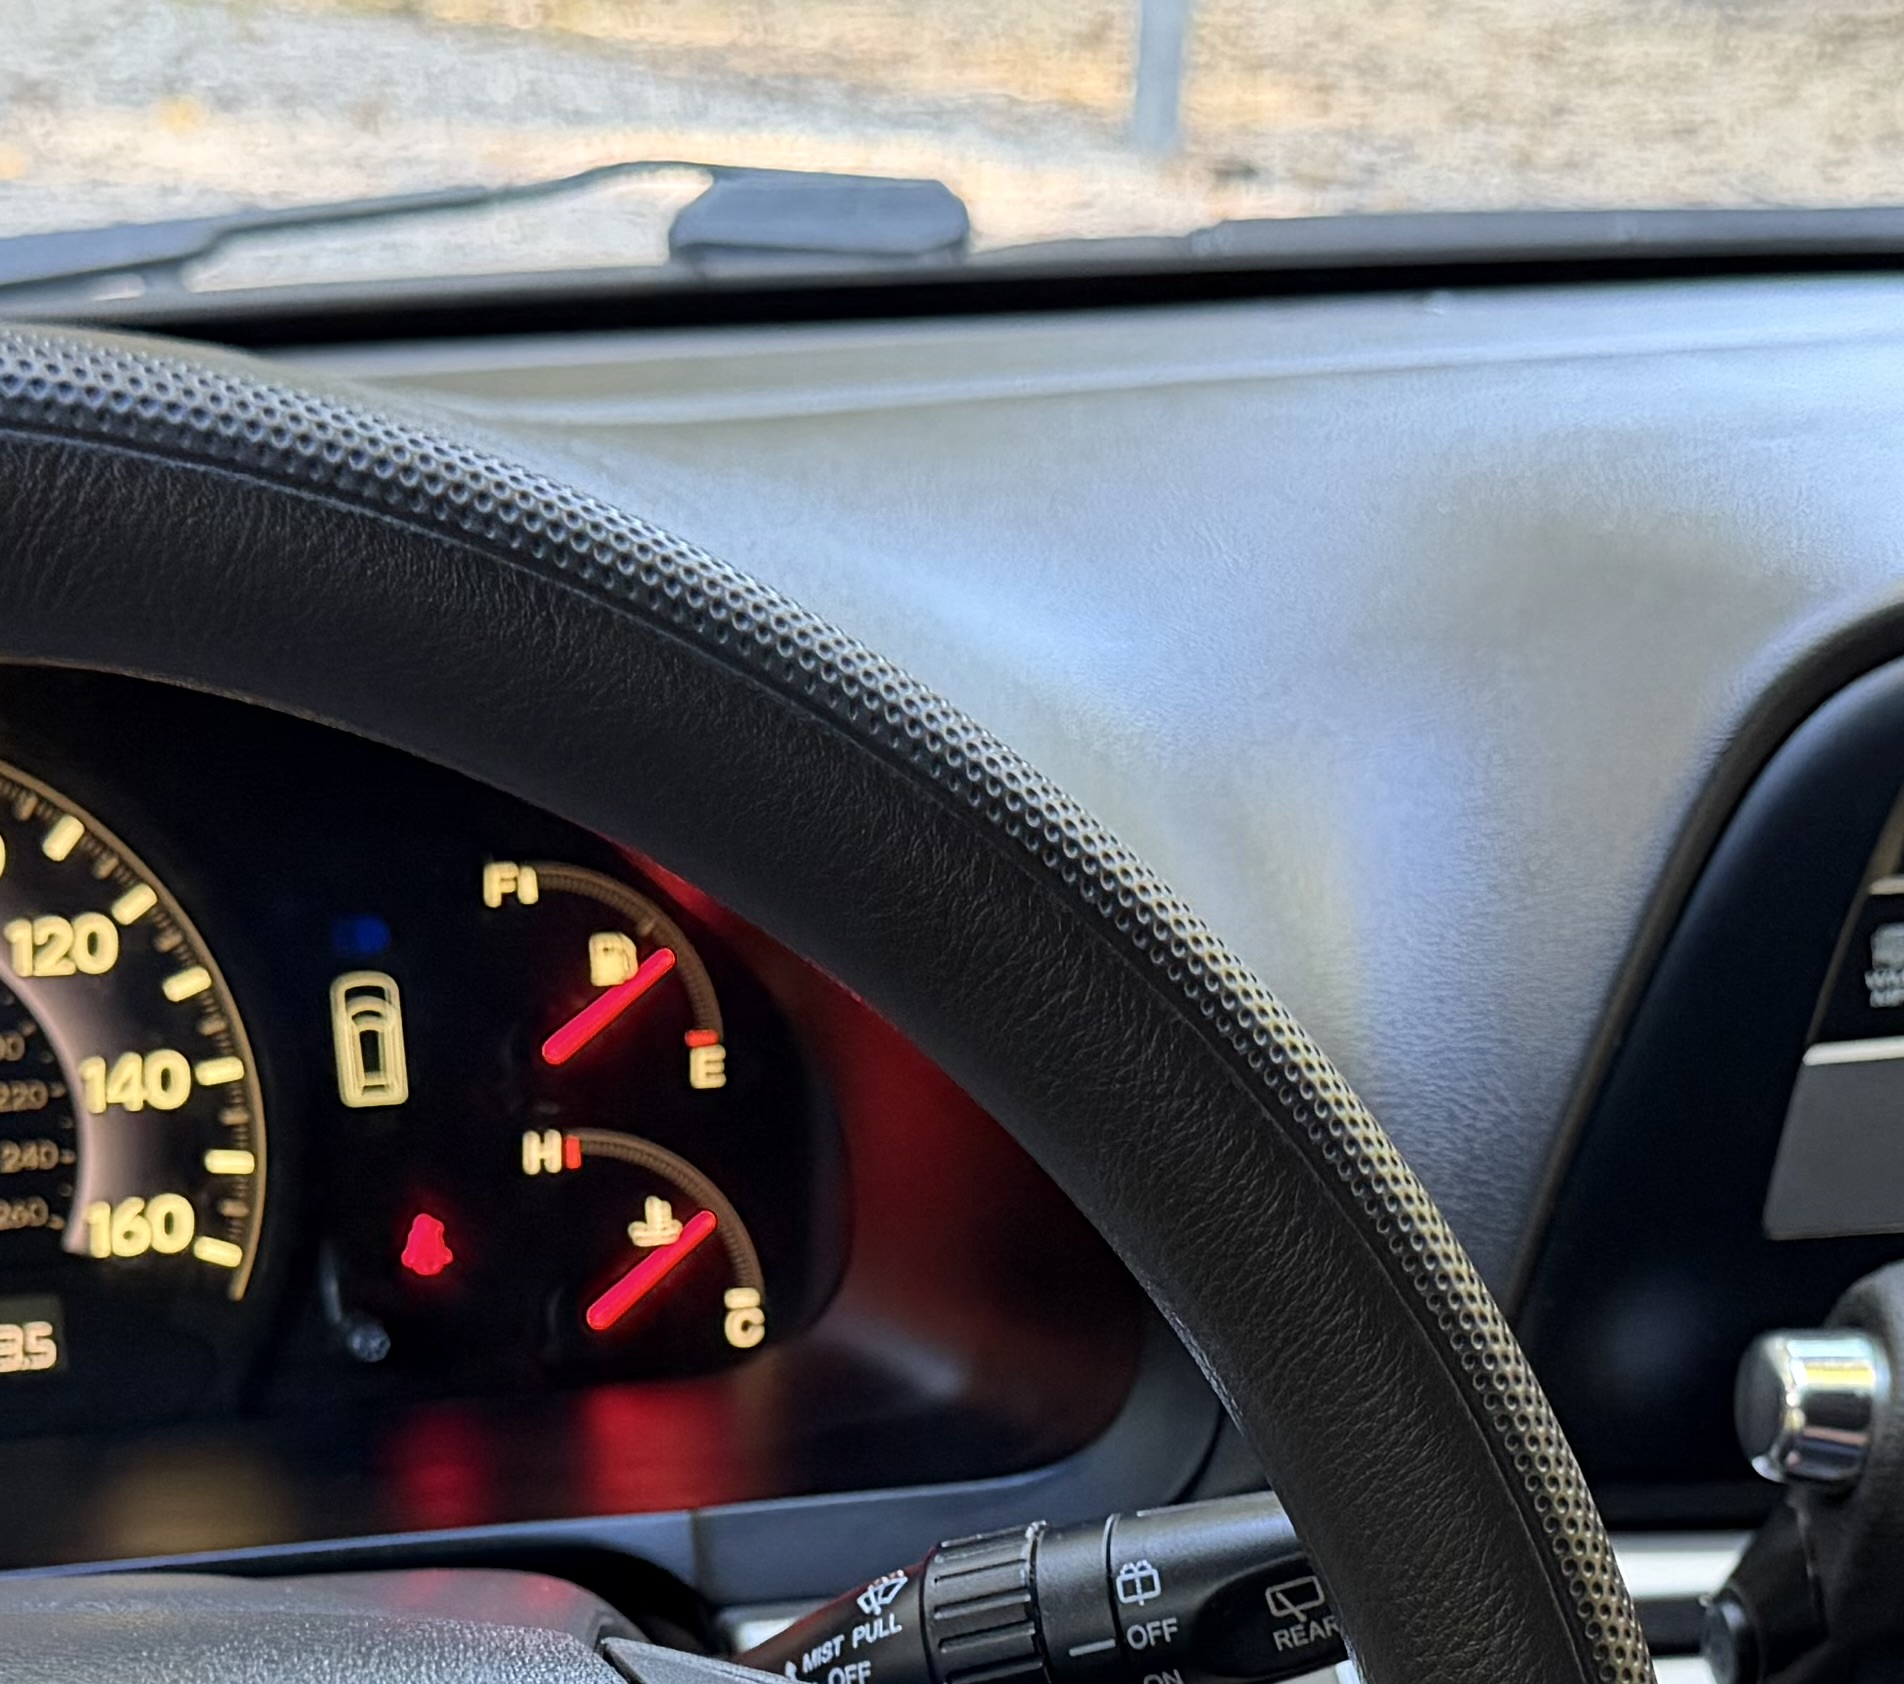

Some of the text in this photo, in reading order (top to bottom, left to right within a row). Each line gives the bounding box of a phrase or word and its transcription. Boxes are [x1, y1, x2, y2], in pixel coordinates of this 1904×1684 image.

[483, 861, 520, 908] F
[3, 912, 120, 980] 120
[78, 1048, 193, 1115] 140
[689, 1043, 727, 1089] E
[521, 1129, 563, 1176] H
[84, 1192, 196, 1258] 160
[724, 1307, 765, 1348] C
[802, 1613, 902, 1674] MIST PULL
[1127, 1617, 1178, 1650] OFF
[1272, 1615, 1342, 1651] REAR
